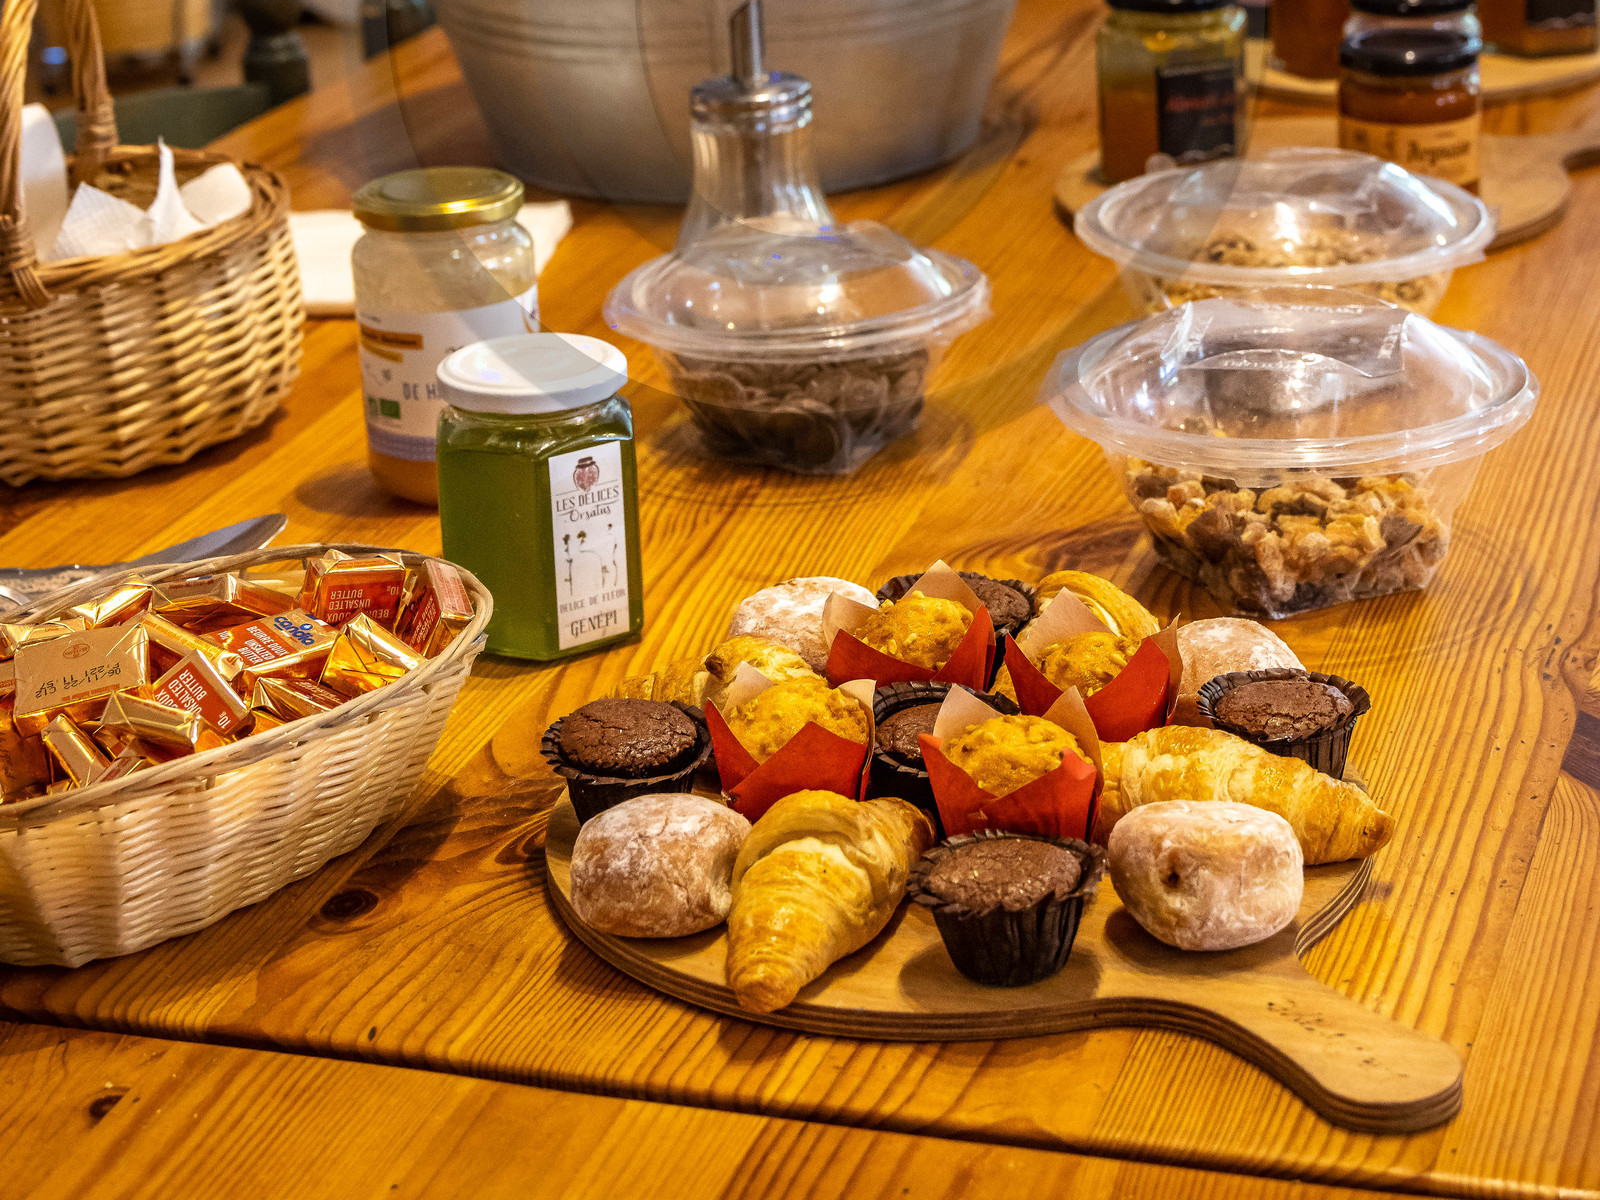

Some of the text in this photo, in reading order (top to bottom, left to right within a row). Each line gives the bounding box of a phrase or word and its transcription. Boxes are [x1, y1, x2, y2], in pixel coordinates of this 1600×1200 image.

[556, 496, 576, 513] LES
[328, 598, 371, 611] UNSALTED
[330, 588, 363, 600] BUTTER
[589, 595, 598, 607] DE
[602, 588, 626, 603] FLEUR
[246, 625, 290, 656] BEURRE DOUX
[273, 616, 315, 646] candia
[237, 646, 263, 665] BUTTER
[244, 638, 276, 661] UNSALTED
[179, 669, 207, 701] BUTTER
[168, 679, 202, 714] UNSALTED
